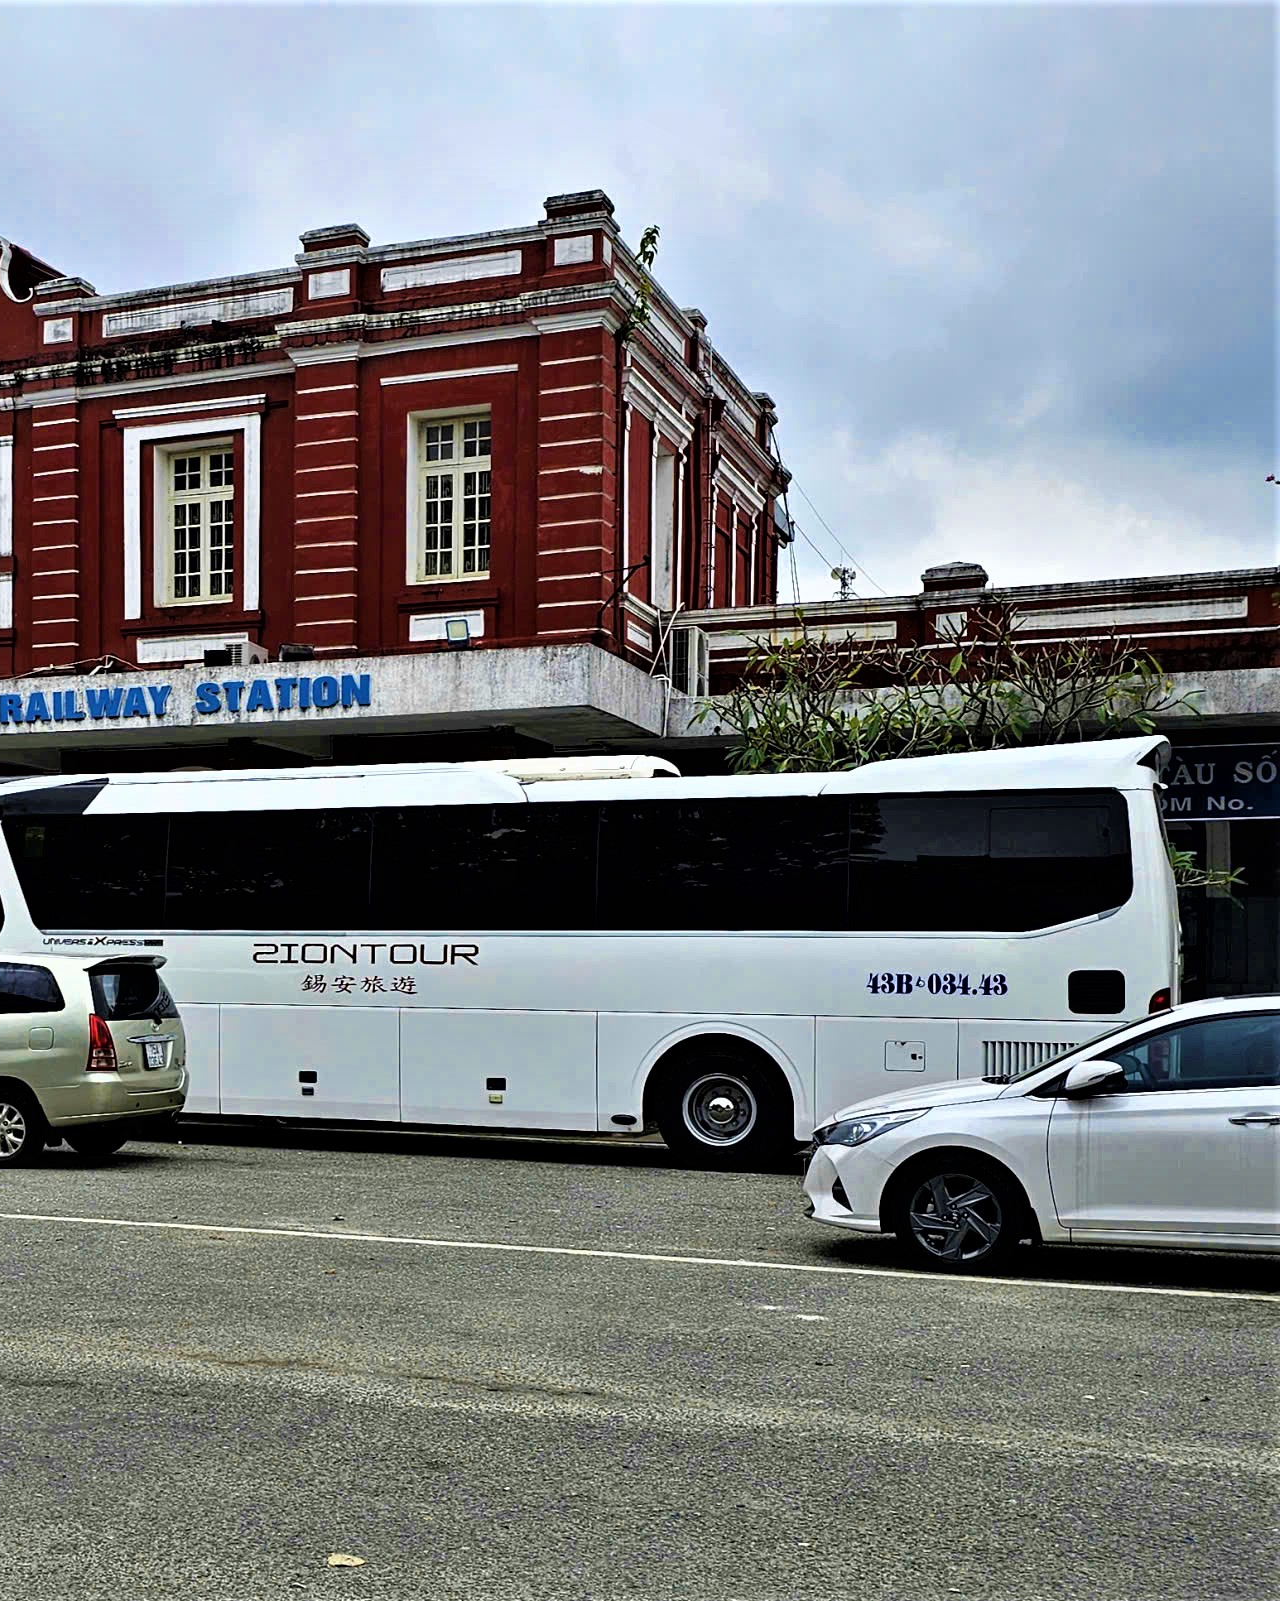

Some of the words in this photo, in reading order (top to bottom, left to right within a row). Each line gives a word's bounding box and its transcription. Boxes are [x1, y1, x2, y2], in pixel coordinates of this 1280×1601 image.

[0, 685, 172, 724] RAILWAY
[195, 674, 372, 714] STATION
[1232, 749, 1278, 784] SỐ
[1207, 796, 1254, 811] No.
[253, 943, 479, 965] ZIONTOUR
[301, 974, 418, 995] 錫安旅遊
[866, 972, 913, 995] 43B
[927, 973, 1008, 996] 034.43
